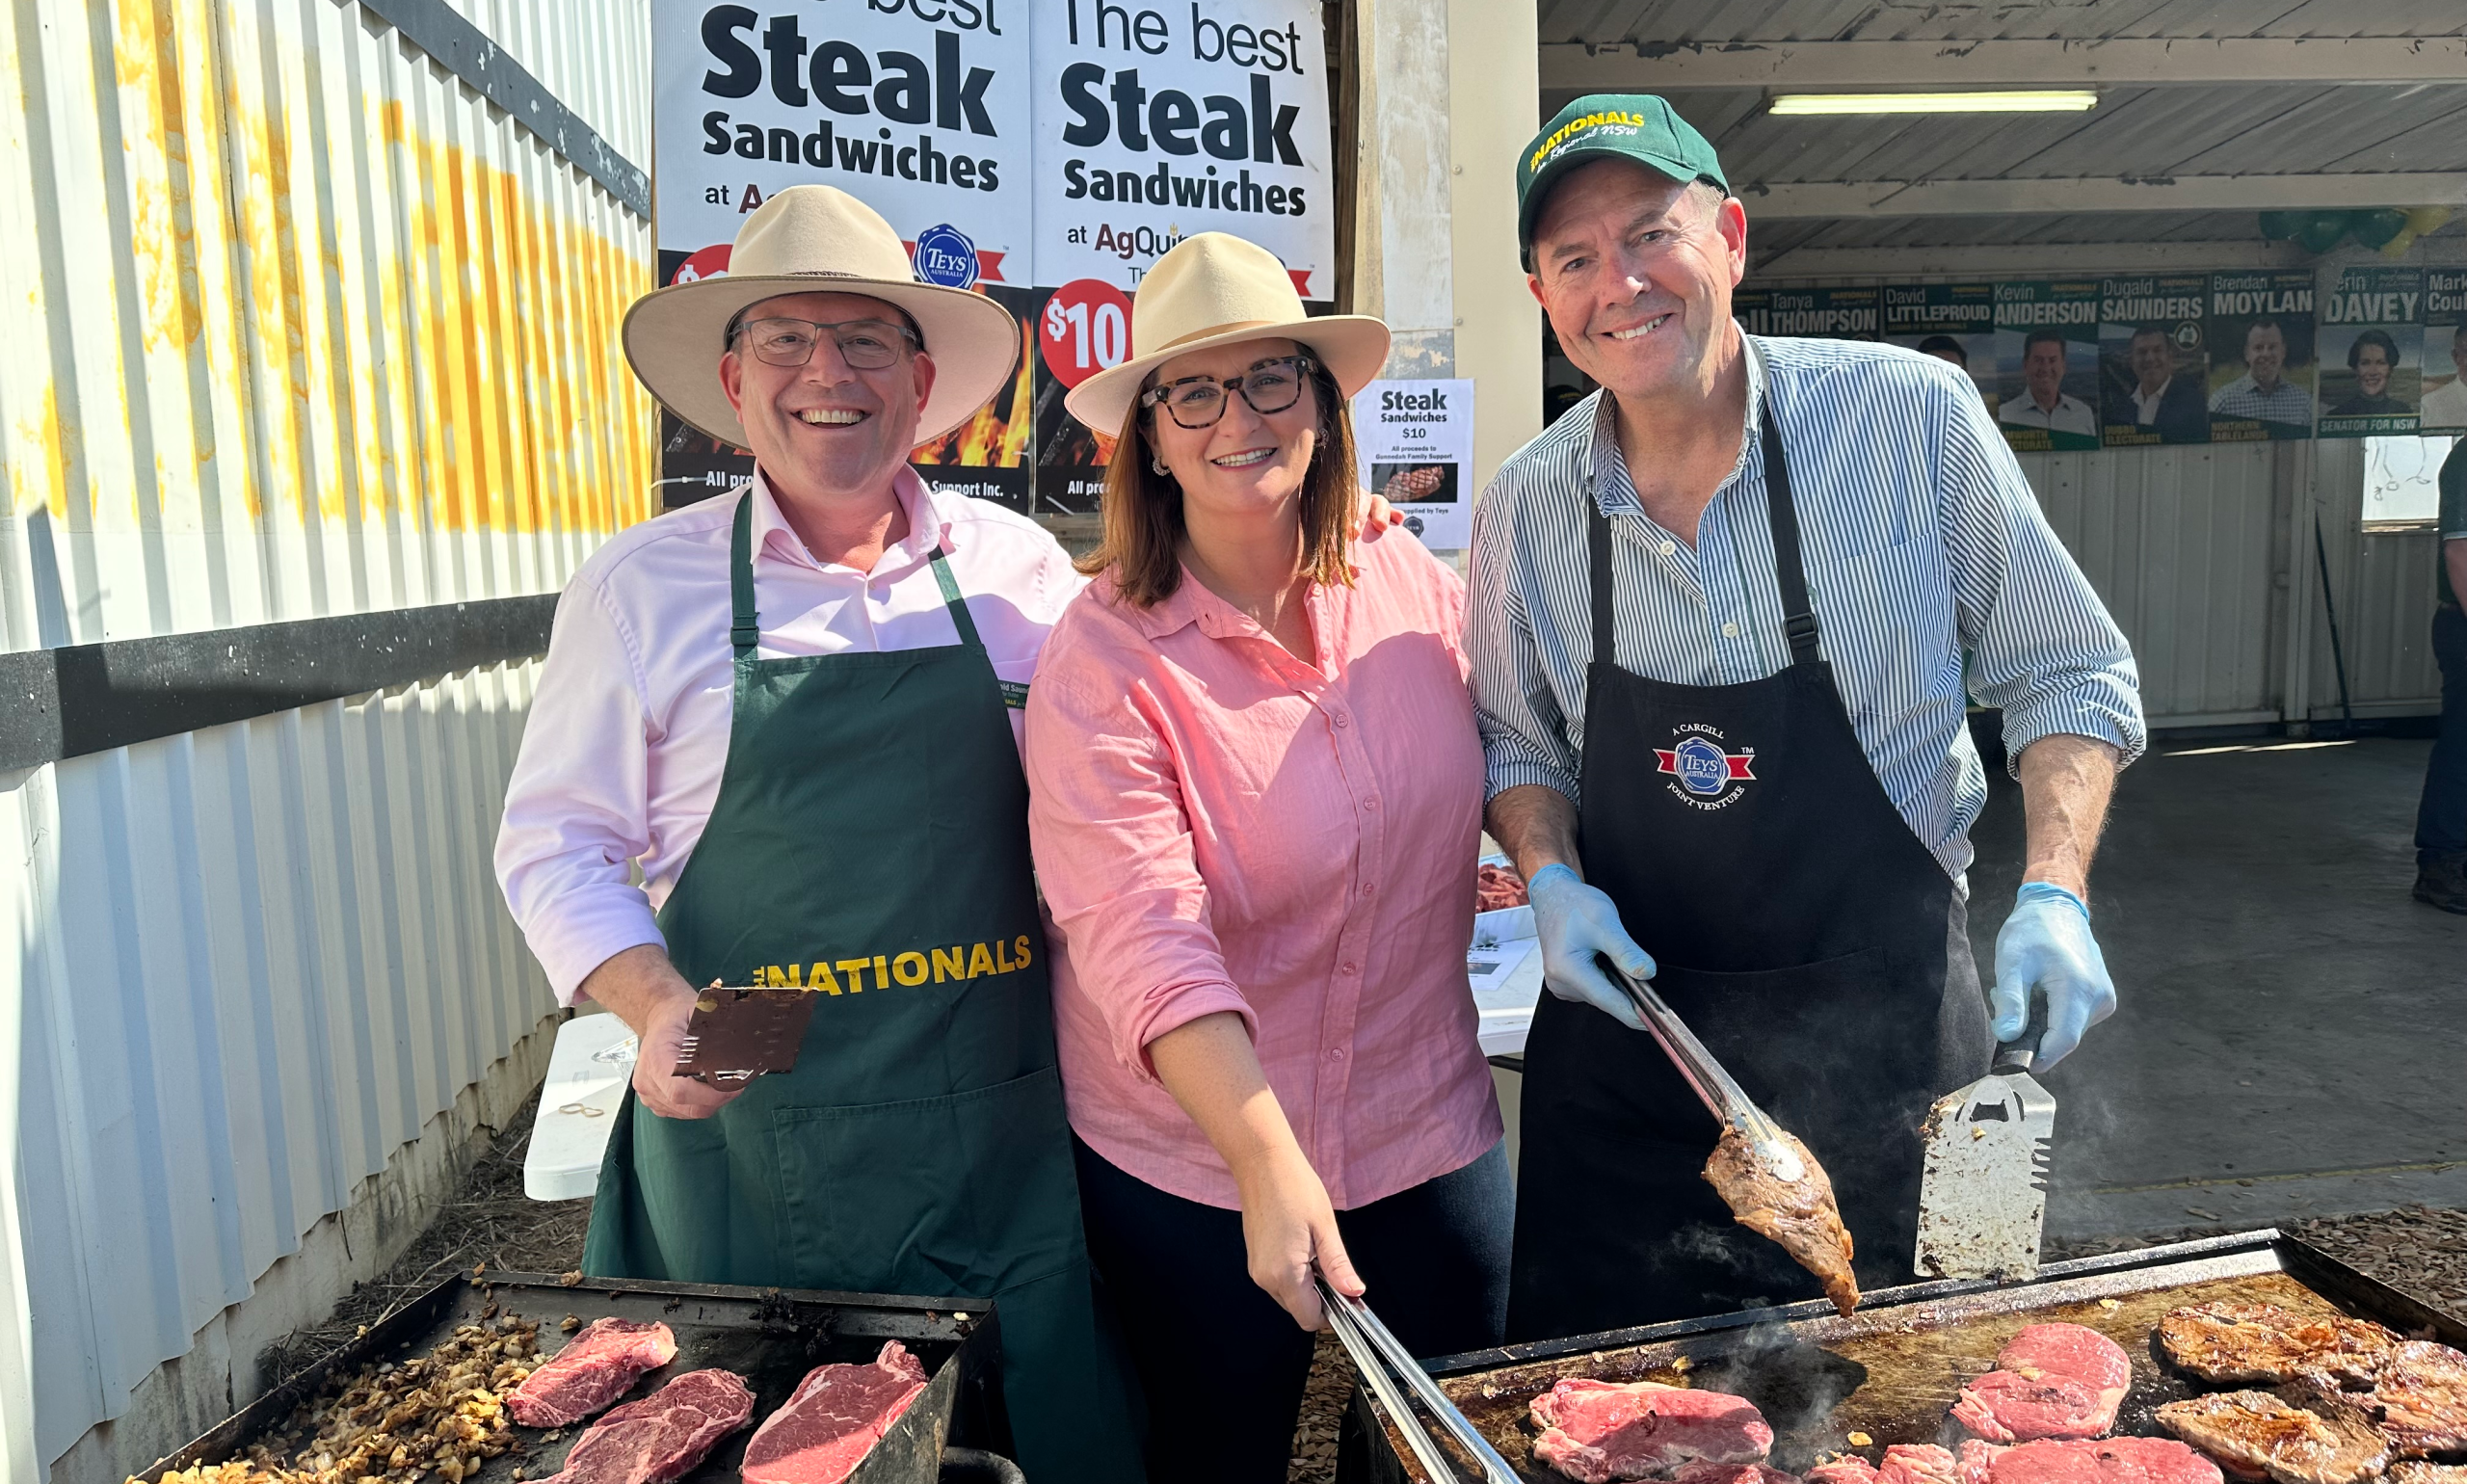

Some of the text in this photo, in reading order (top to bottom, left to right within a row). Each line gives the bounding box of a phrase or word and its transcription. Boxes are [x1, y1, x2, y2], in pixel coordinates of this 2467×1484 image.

[1191, 2, 1304, 75] best
[702, 4, 998, 138] Steak
[1060, 62, 1304, 167] Steak
[1534, 111, 1644, 166] NATIONALS
[1550, 127, 1598, 160] Regional
[1601, 125, 1637, 136] NSW
[703, 111, 998, 192] Sandwiches
[705, 185, 729, 205] at
[1064, 159, 1306, 216] Sandwiches
[1068, 223, 1188, 259] at AgQui
[928, 249, 967, 272] TEYS
[930, 269, 964, 278] AUSTRALIA
[2214, 276, 2268, 291] Brendan
[1886, 288, 1925, 305] David
[1995, 284, 2034, 302] Kevin
[2103, 278, 2153, 299] Dugald
[1771, 293, 1813, 311] Tanya
[1888, 305, 1990, 322] LITTLEPROUD
[1994, 302, 2097, 325] ANDERSON
[2102, 297, 2203, 321] SAUNDERS
[2214, 290, 2312, 315] MOYLAN
[2325, 292, 2418, 323] DAVEY
[1771, 308, 1876, 334] THOMPSON
[1047, 298, 1126, 369] $10
[1382, 388, 1446, 411] Steak
[1381, 412, 1446, 423] Sandwiches
[2321, 418, 2417, 432] SENATOR FOR NSW
[1402, 428, 1426, 438] $10
[706, 471, 754, 490] All pro
[983, 482, 1003, 496] Inc.
[1068, 481, 1083, 494] All
[1673, 724, 1724, 739] A CARGILL
[1684, 755, 1718, 772] TEYS
[1685, 770, 1719, 780] AUSTRALIA
[1667, 782, 1745, 810] JOINT VENTURE
[767, 935, 1031, 995] NATIONALS
